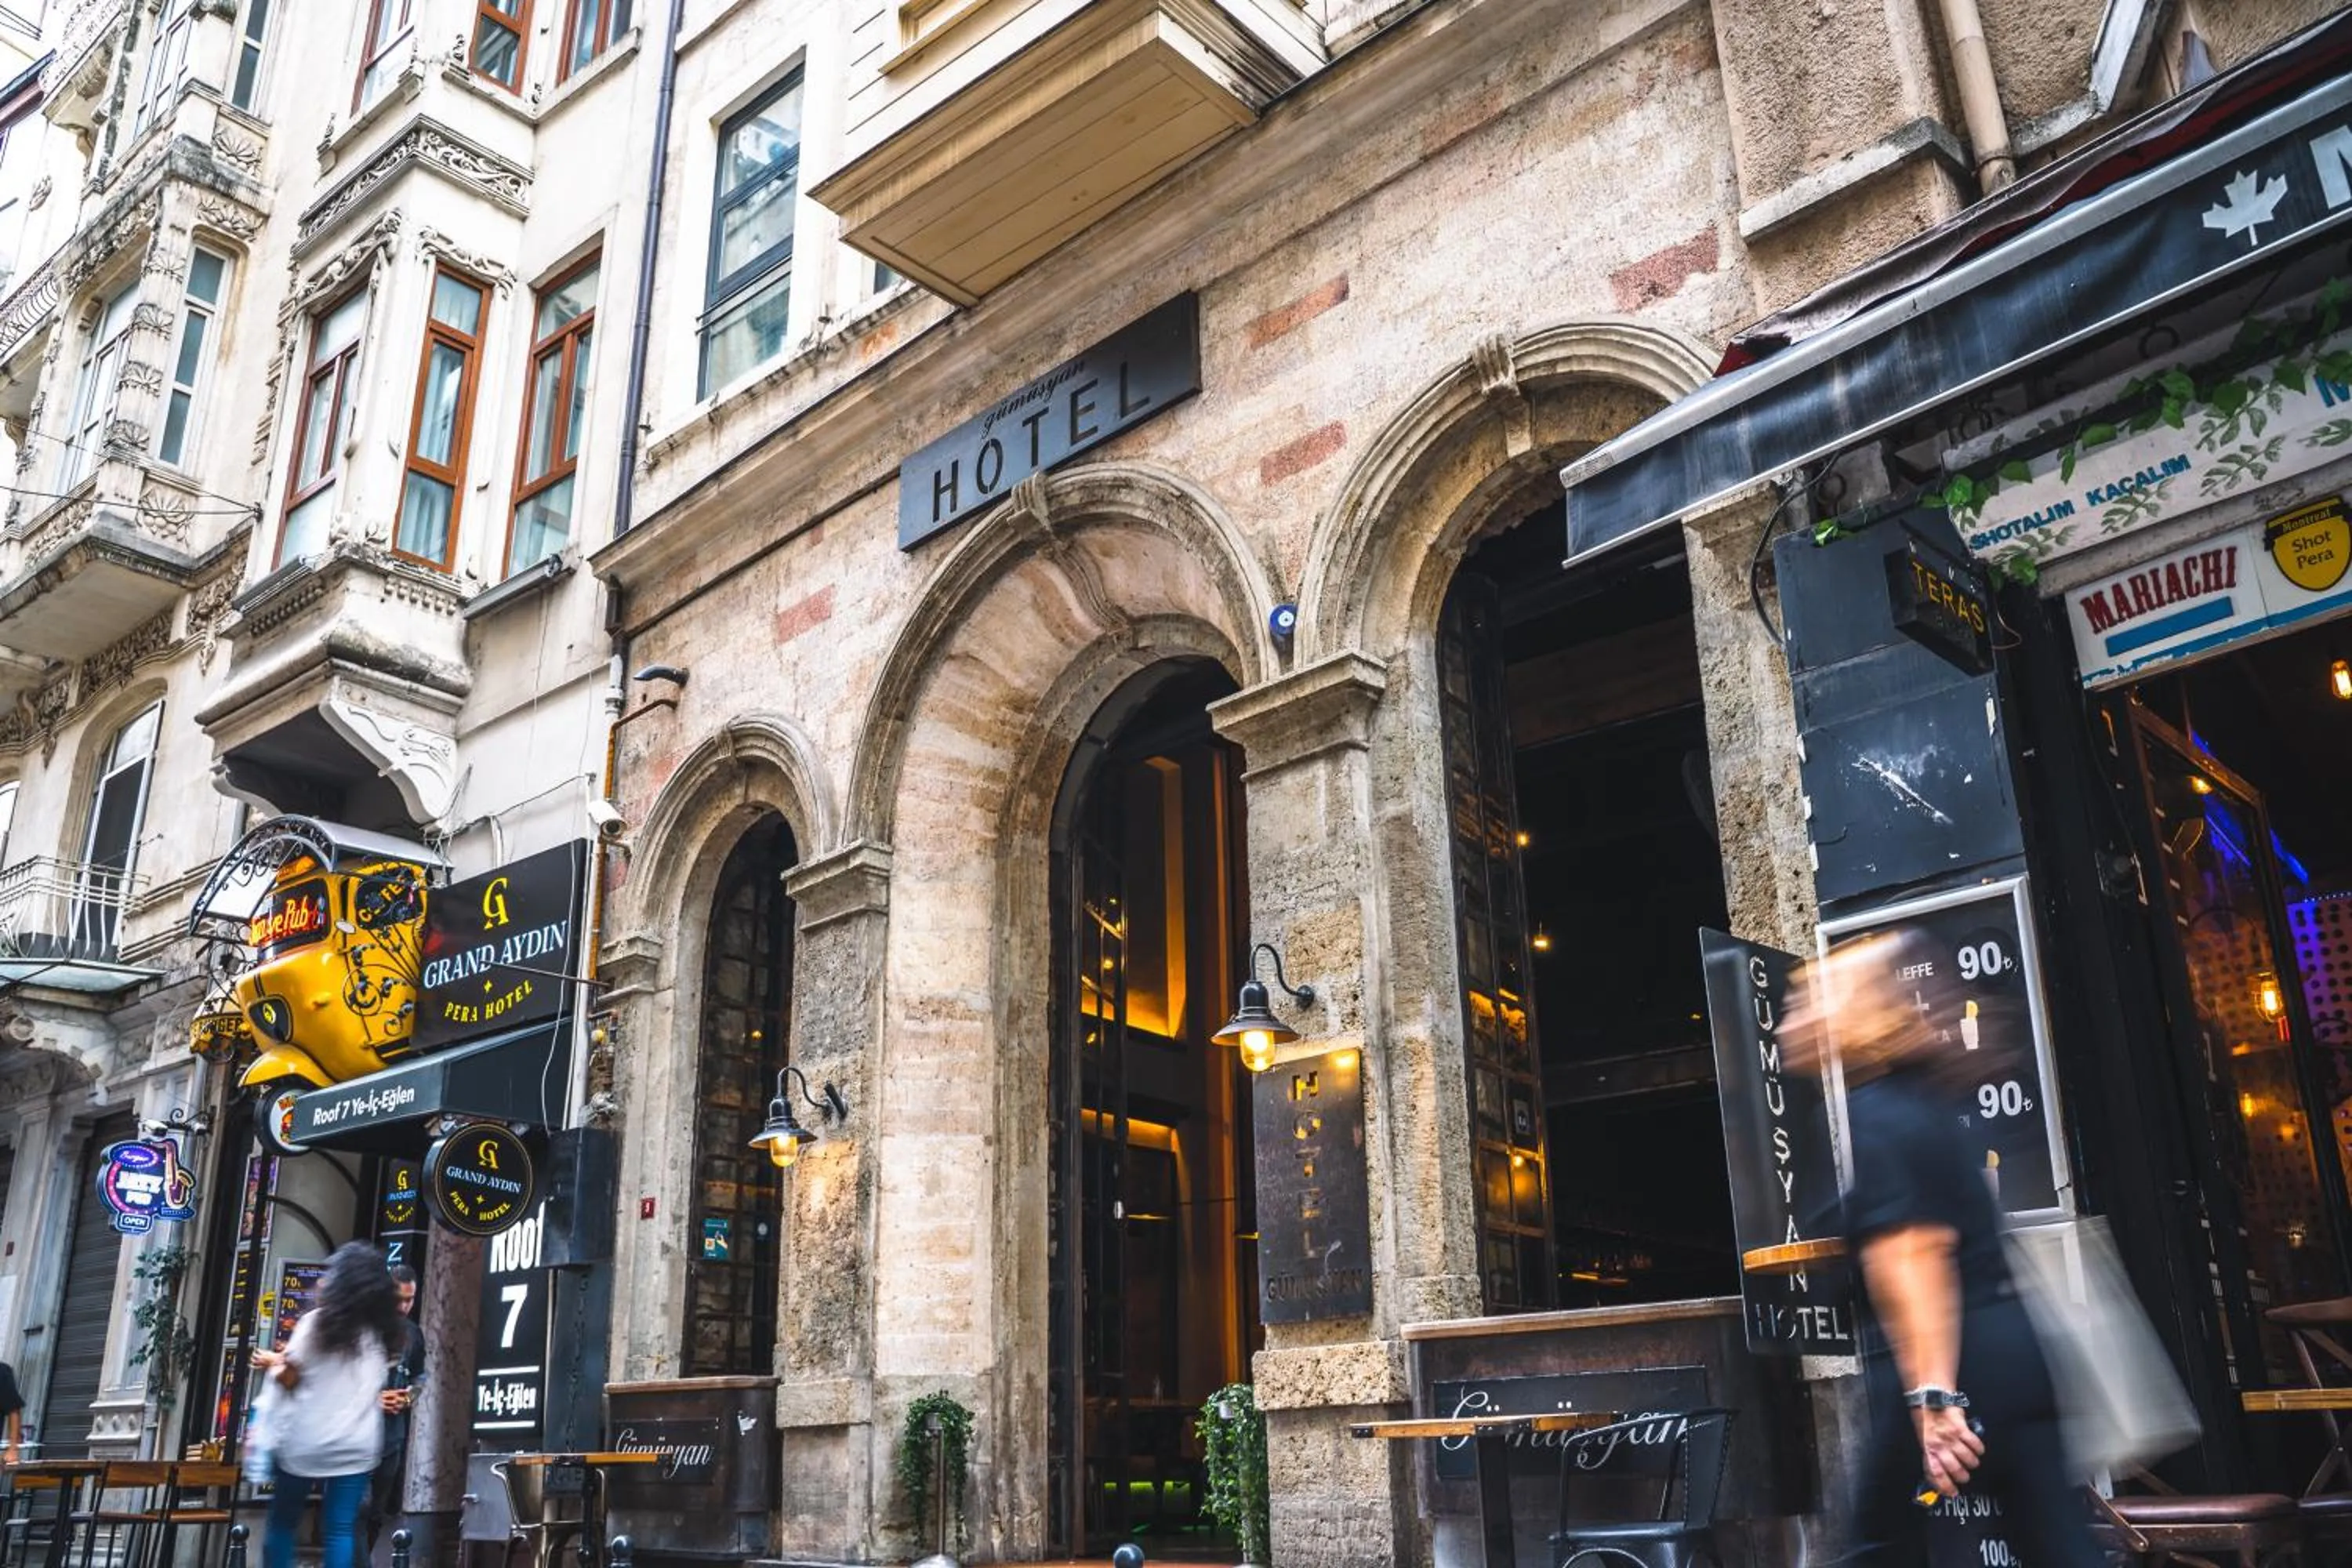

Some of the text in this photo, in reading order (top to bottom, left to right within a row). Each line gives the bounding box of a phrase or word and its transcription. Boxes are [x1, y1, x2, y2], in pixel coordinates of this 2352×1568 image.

[932, 361, 1150, 524] HOTEL
[1969, 499, 2076, 550] SHOTALIM
[2292, 530, 2332, 553] Shot
[2296, 550, 2335, 570] Pera
[1911, 561, 1985, 633] TERAS
[2079, 546, 2238, 635] MARIACHI
[423, 919, 568, 989] GRAND AYDIN
[445, 979, 533, 1022] PERA HOTEL
[313, 1102, 341, 1126] Roof
[341, 1099, 350, 1120] 7
[446, 1165, 522, 1194] GRAND AYDIN
[1289, 1070, 1322, 1259] HOTEL
[123, 1216, 146, 1226] OPEN
[449, 1190, 512, 1221] PERA HOTEL
[500, 1283, 528, 1348] 7
[1755, 1303, 1849, 1340] HOTEL
